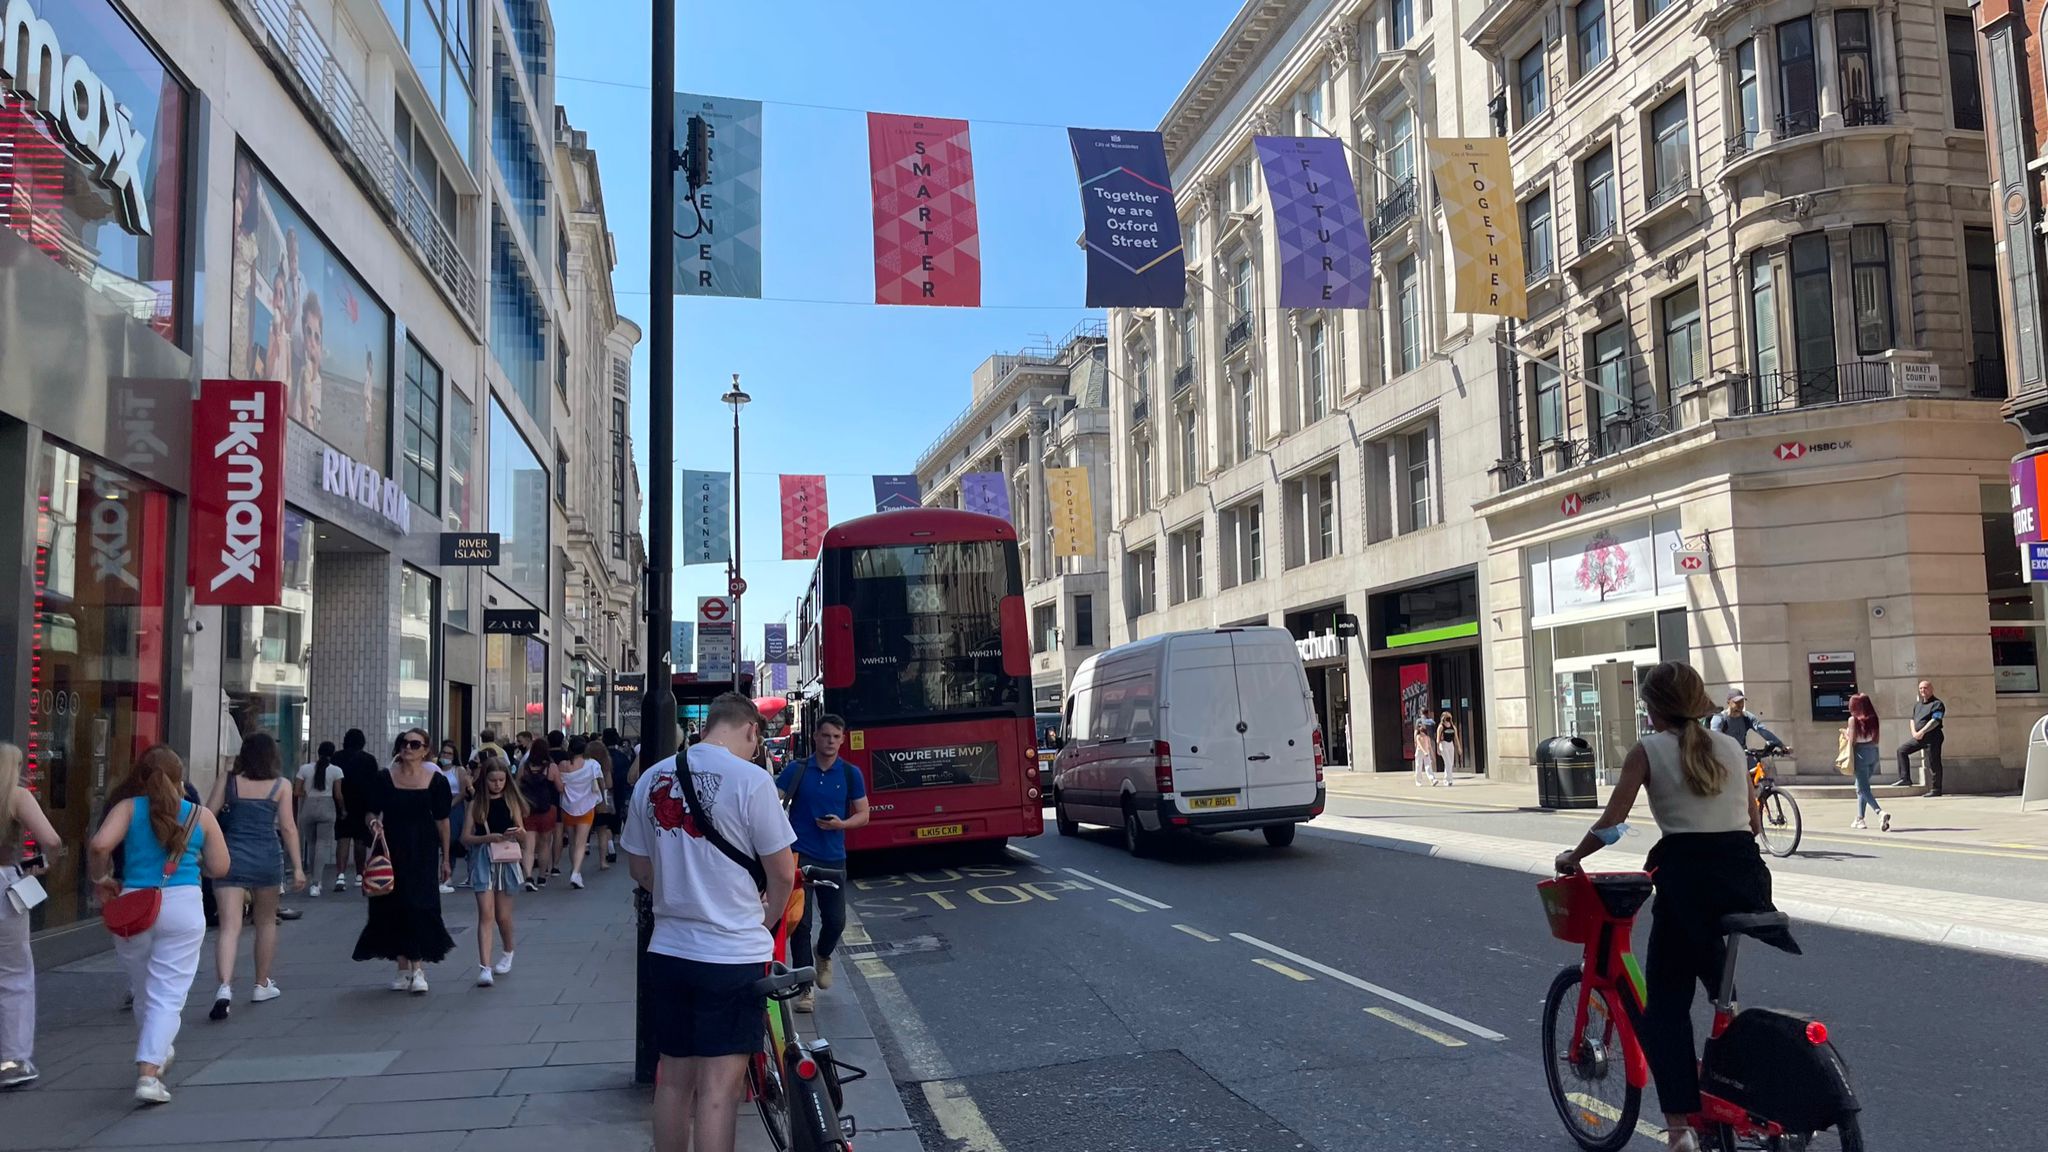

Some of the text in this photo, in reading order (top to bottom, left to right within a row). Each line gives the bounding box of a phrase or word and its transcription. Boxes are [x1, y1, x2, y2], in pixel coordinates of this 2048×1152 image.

[1094, 187, 1159, 204] Together
[1107, 205, 1153, 217] we are
[912, 141, 935, 298] SMARTER
[1107, 218, 1158, 232] Oxford
[1301, 159, 1334, 300] FUTURE
[1468, 162, 1499, 307] TOGETHER
[1112, 234, 1158, 248] Street
[1905, 365, 1930, 373] MARKET
[1905, 373, 1926, 382] COURT
[1809, 440, 1853, 452] HSBC UK
[322, 447, 380, 513] RIVER
[702, 483, 710, 560] GREENER
[800, 485, 809, 557] SMARTER
[1066, 481, 1077, 552] TOGETHER
[458, 538, 488, 548] RIVER
[454, 549, 492, 559] ISLAND
[730, 582, 745, 591] OP
[487, 620, 535, 629] ZARA
[862, 656, 897, 665] VWH2116
[968, 650, 1002, 659] VWH2116
[613, 684, 639, 692] Bershka
[889, 746, 983, 762] YOU'RE THE MVP
[869, 804, 894, 812] OLVO
[921, 825, 958, 836] LK15 CXR
[853, 864, 1016, 890] BUS
[854, 879, 1077, 918] STOP
